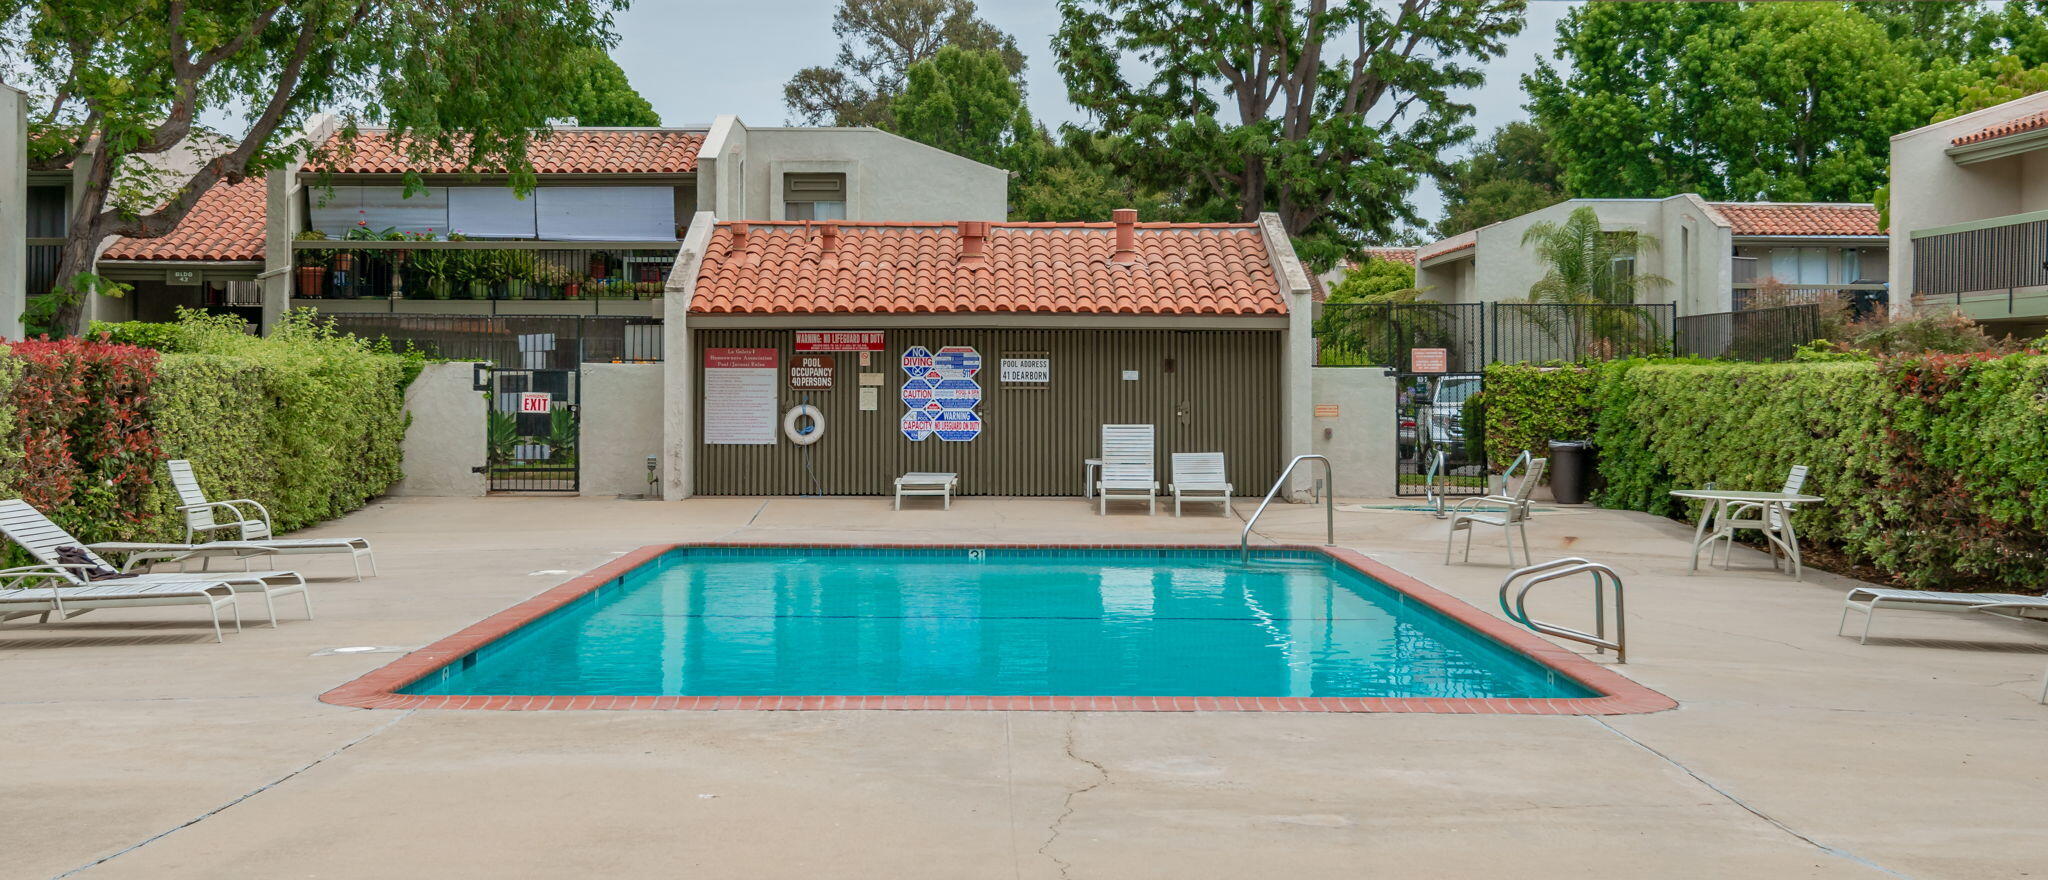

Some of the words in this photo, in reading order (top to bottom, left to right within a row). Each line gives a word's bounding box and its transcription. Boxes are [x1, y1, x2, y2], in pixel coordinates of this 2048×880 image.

[796, 334, 822, 344] WARNING:
[824, 334, 830, 344] NO
[832, 334, 860, 344] LIFEGUARD
[862, 334, 869, 344] ON
[870, 334, 884, 344] DUTY
[912, 348, 924, 357] NO
[803, 358, 821, 367] POOL
[904, 358, 932, 366] DIVING
[792, 368, 832, 377] OCCUPANCY
[1003, 372, 1010, 380] 41
[1013, 372, 1047, 380] DEARBORN
[792, 378, 800, 386] 40
[802, 378, 832, 386] PERSONS
[903, 390, 932, 398] CAUTION
[524, 398, 548, 411] EXIT
[944, 411, 971, 420] WARNING
[903, 421, 932, 430] CAPACITY
[935, 422, 940, 430] NO
[942, 422, 962, 430] LIFEGUARD
[963, 422, 968, 430] ON
[970, 422, 979, 430] DUTY
